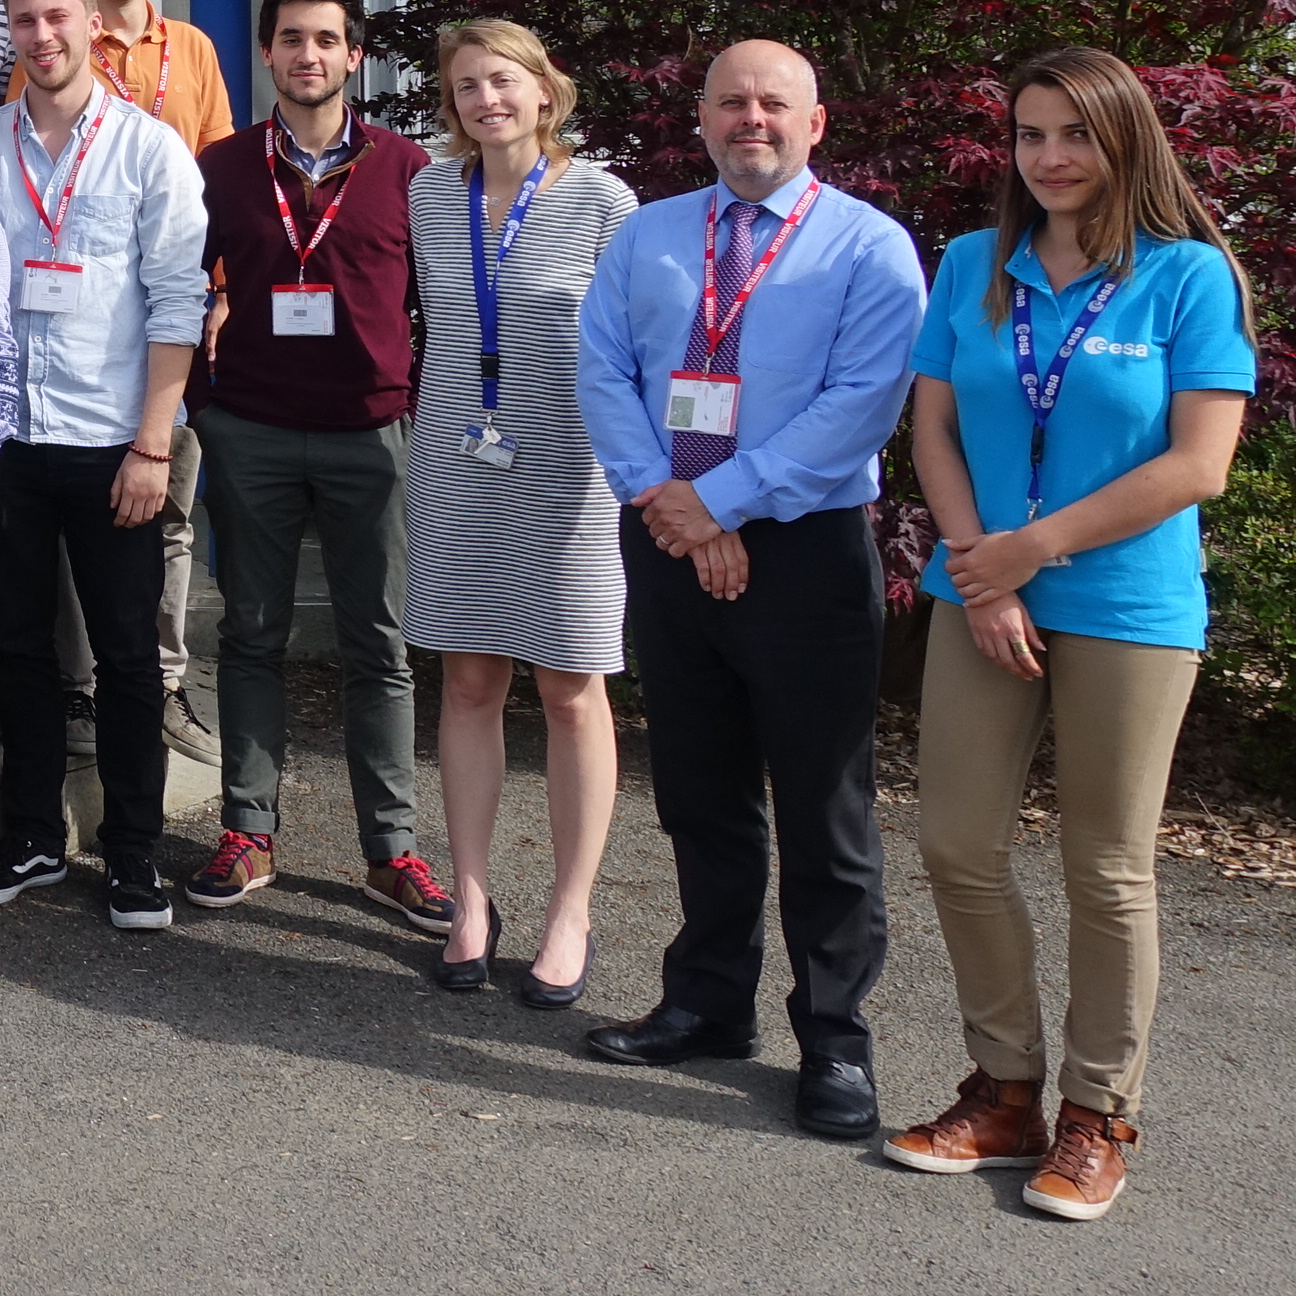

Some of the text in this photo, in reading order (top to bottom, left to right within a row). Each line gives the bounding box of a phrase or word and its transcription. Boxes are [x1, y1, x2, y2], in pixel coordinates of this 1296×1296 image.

[106, 66, 129, 97] VISITOR
[159, 62, 168, 91] VISITOR
[81, 126, 98, 152] VISITEUR
[67, 160, 81, 188] VISITEUR
[56, 196, 69, 226] VISITEUR
[793, 190, 815, 216] VISITEUR
[283, 216, 298, 251] VISITOR
[308, 218, 331, 249] VISITOR
[706, 221, 714, 250] VISITEUR
[769, 223, 794, 253] VISITEUR
[706, 258, 714, 288] VISITEUR
[742, 263, 768, 292] VISITEUR
[706, 297, 714, 329] VISITEUR
[719, 301, 742, 332] VISITEUR
